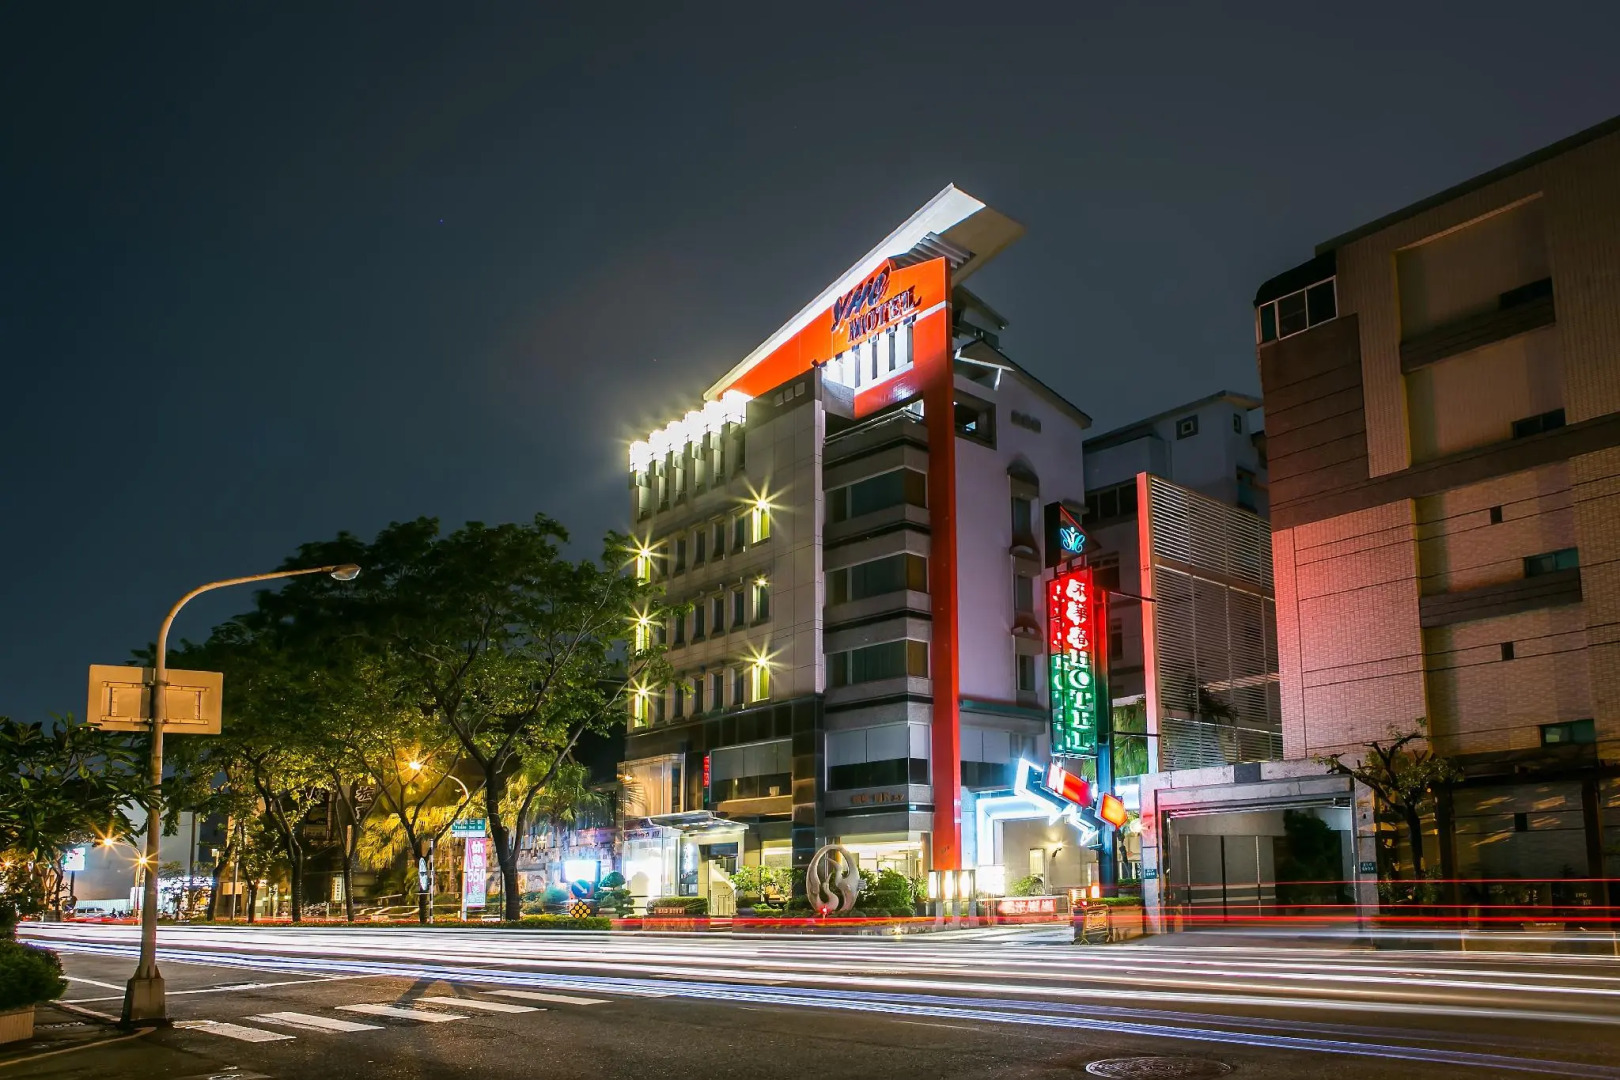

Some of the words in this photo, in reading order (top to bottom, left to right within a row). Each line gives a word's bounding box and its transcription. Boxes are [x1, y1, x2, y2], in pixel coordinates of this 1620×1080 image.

[848, 287, 920, 342] MOTEL
[1068, 648, 1094, 751] HOTEL
[468, 869, 486, 883] 550
